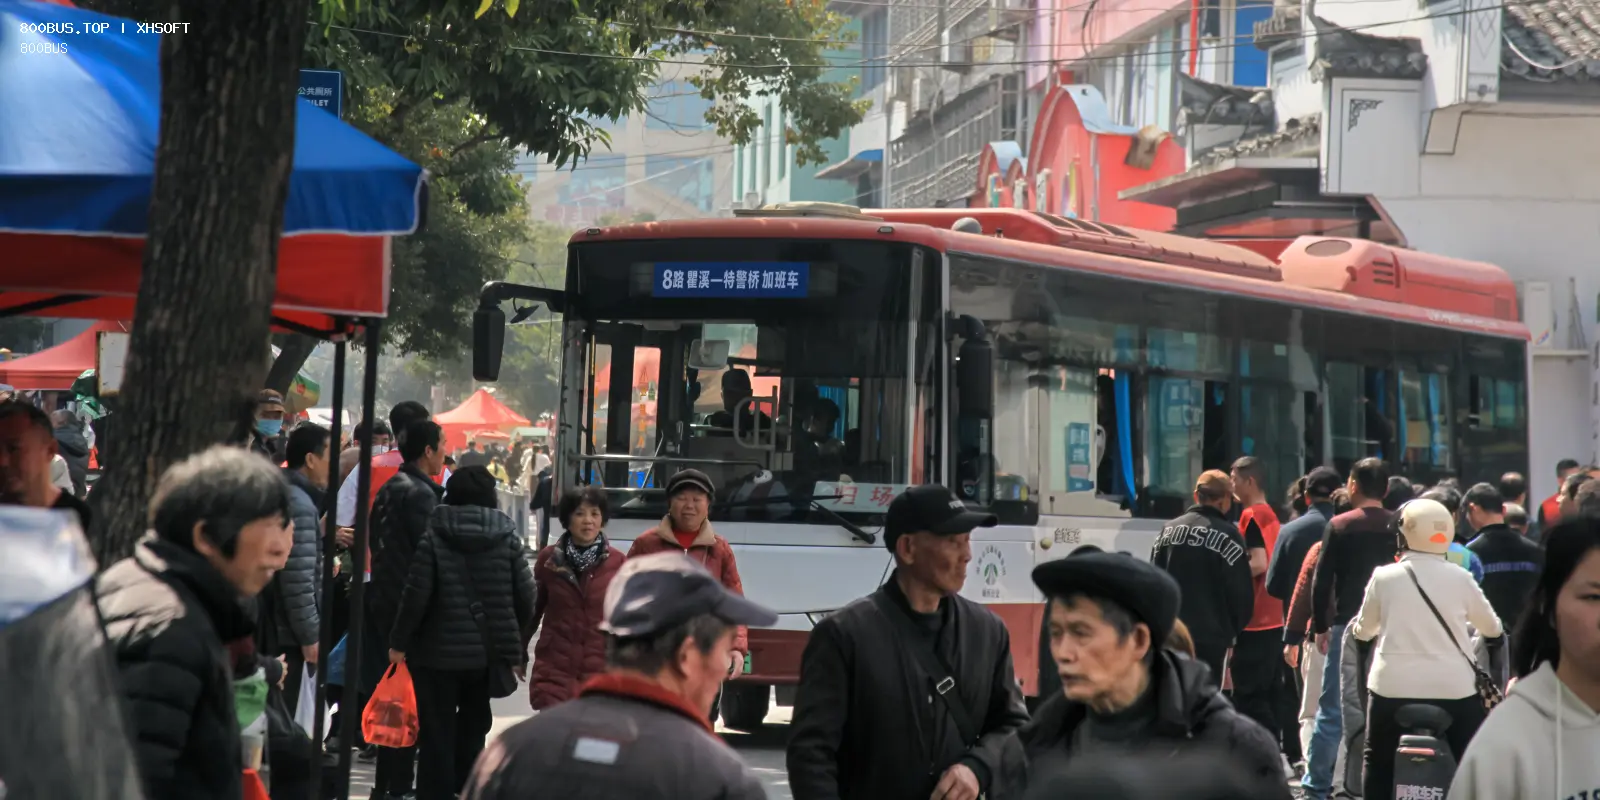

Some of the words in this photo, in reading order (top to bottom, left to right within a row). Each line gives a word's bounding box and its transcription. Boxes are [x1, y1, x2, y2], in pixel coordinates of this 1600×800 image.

[662, 269, 684, 289] 8路
[762, 270, 799, 289] 加班车
